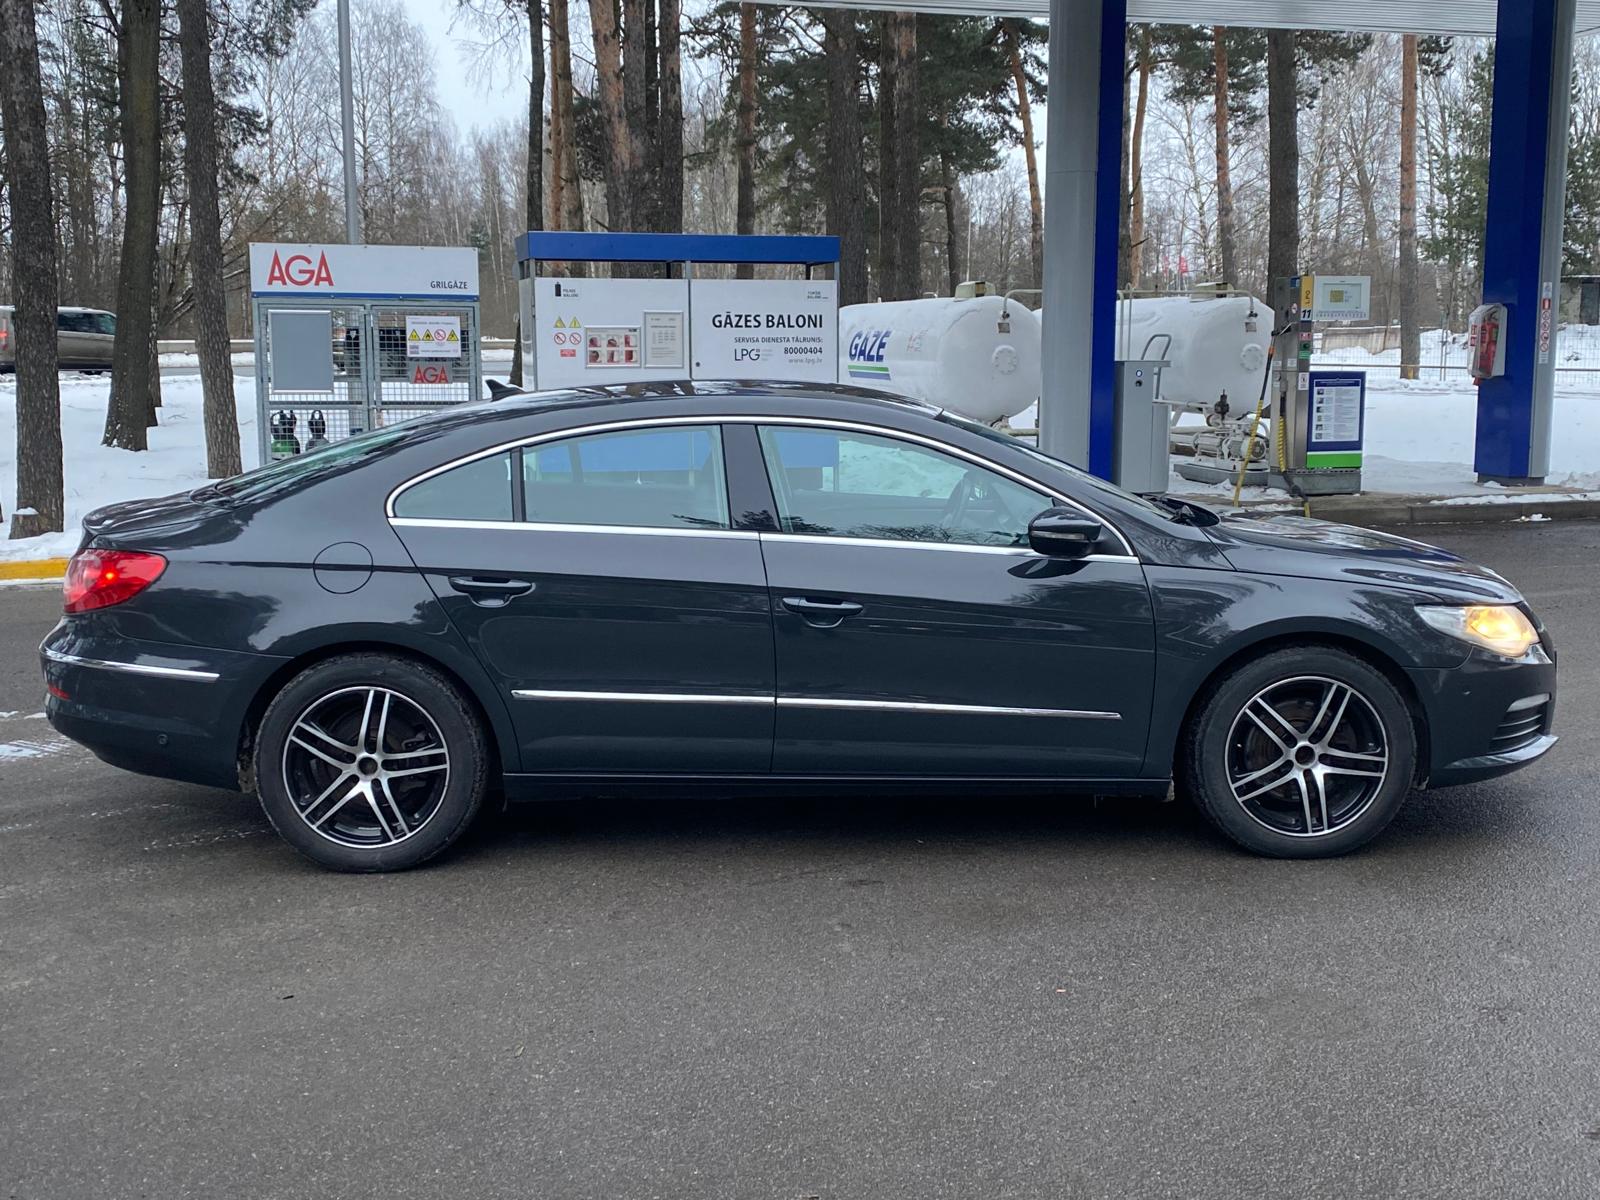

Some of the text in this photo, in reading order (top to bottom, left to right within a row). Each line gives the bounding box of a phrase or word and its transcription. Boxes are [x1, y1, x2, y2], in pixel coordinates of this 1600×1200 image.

[267, 249, 334, 287] AGA
[712, 311, 823, 328] GĀZES BALONI
[1302, 309, 1312, 319] 11
[792, 335, 823, 343] TĀLRUNIS:
[734, 348, 761, 361] LPG
[413, 363, 449, 384] AGA
